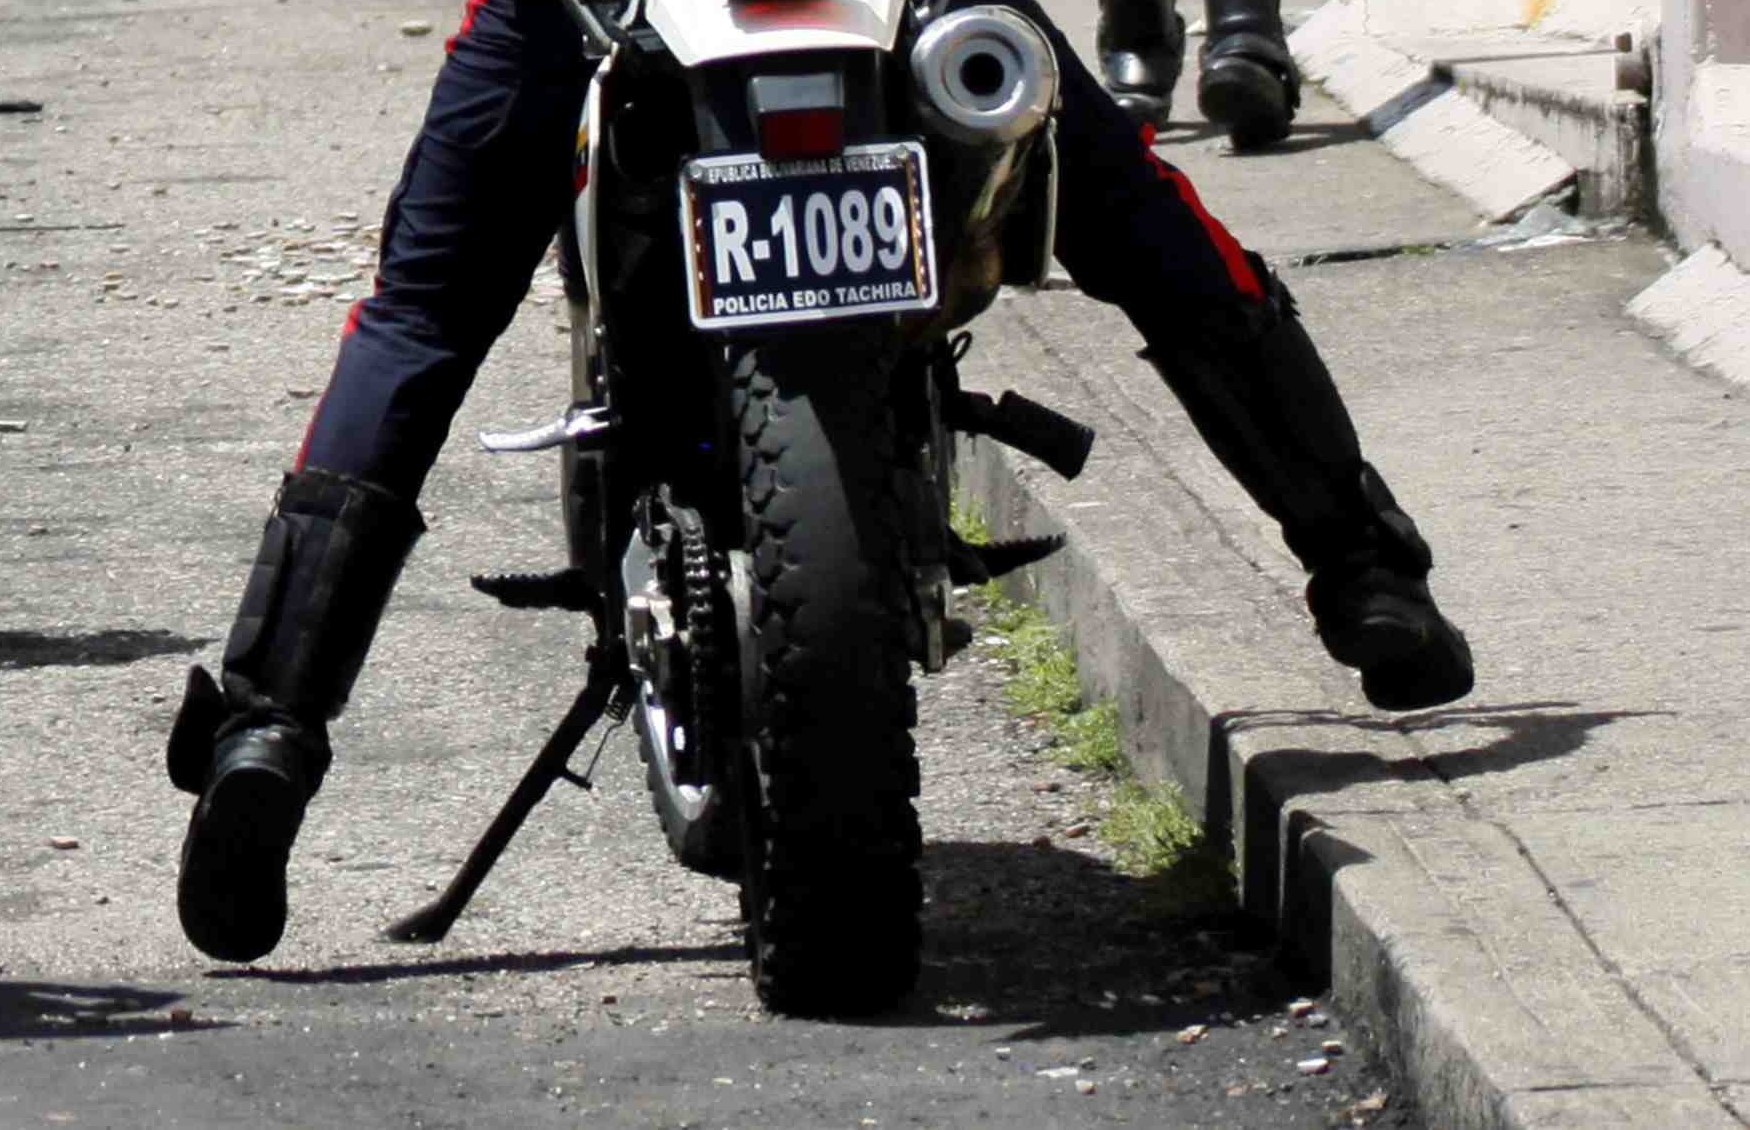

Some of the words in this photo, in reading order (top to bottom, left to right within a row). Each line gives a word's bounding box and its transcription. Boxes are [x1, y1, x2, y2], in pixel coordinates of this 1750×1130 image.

[711, 186, 908, 284] R-1089
[713, 294, 788, 315] POLICIA
[793, 290, 830, 307] EDO
[836, 281, 917, 304] TACHIRA
